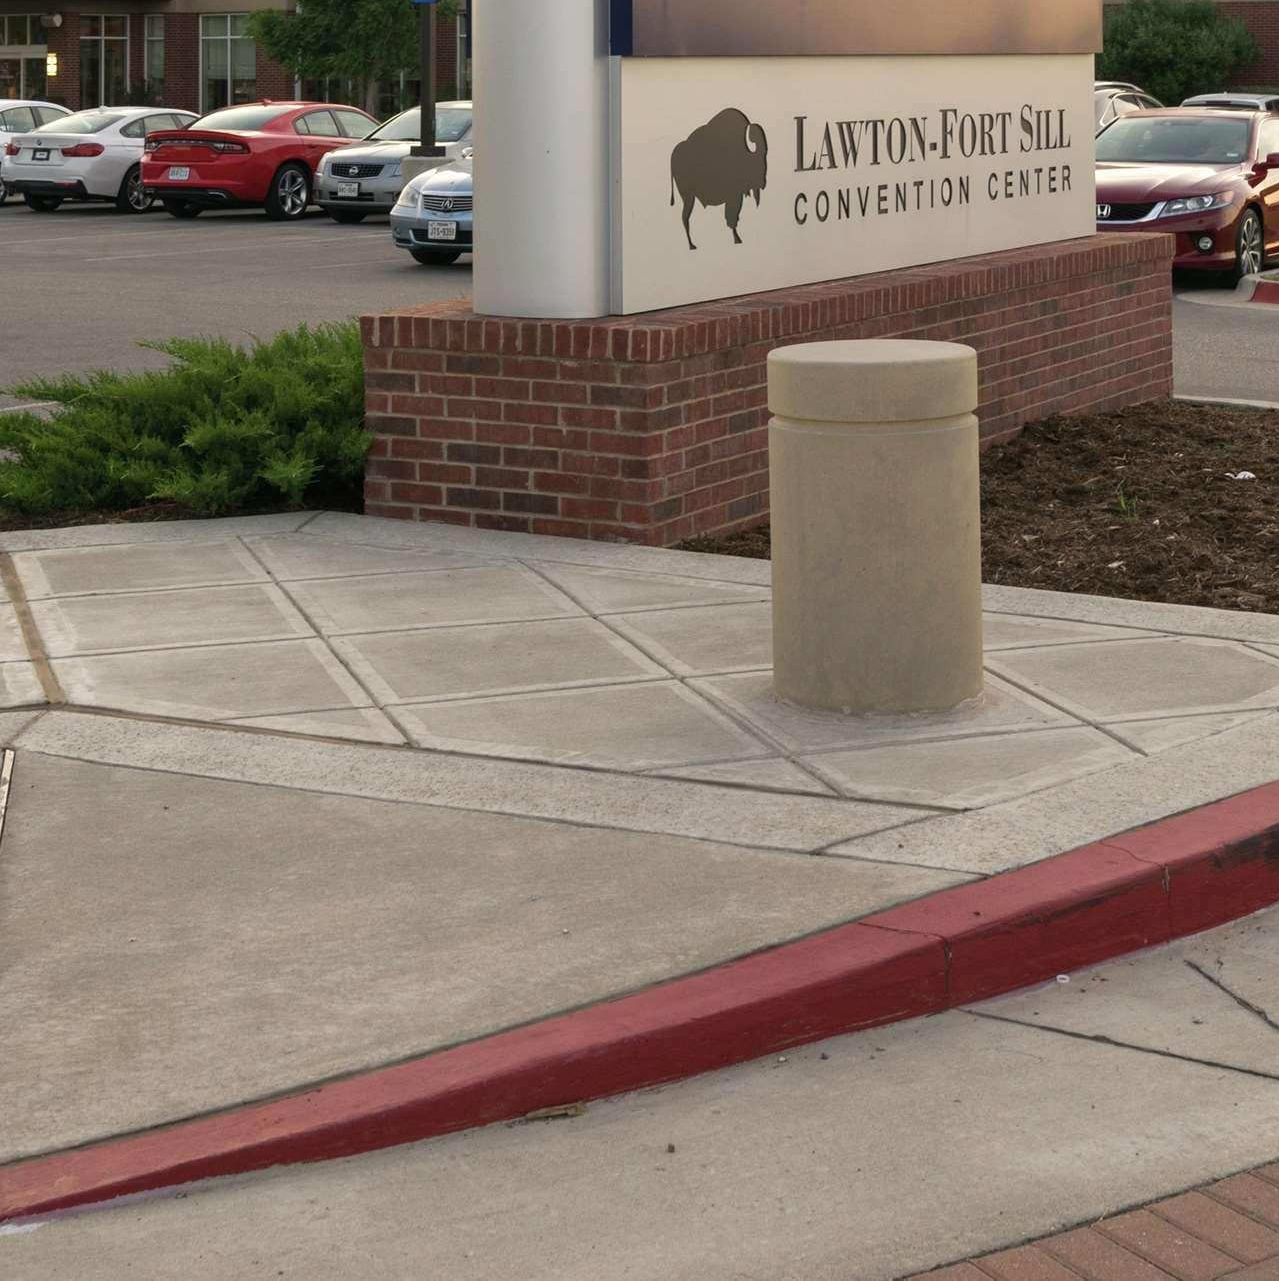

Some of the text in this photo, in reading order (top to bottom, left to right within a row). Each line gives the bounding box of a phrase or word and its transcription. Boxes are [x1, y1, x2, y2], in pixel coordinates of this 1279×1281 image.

[1019, 104, 1072, 152] SILL
[794, 165, 1072, 225] CONVENTION CENTER
